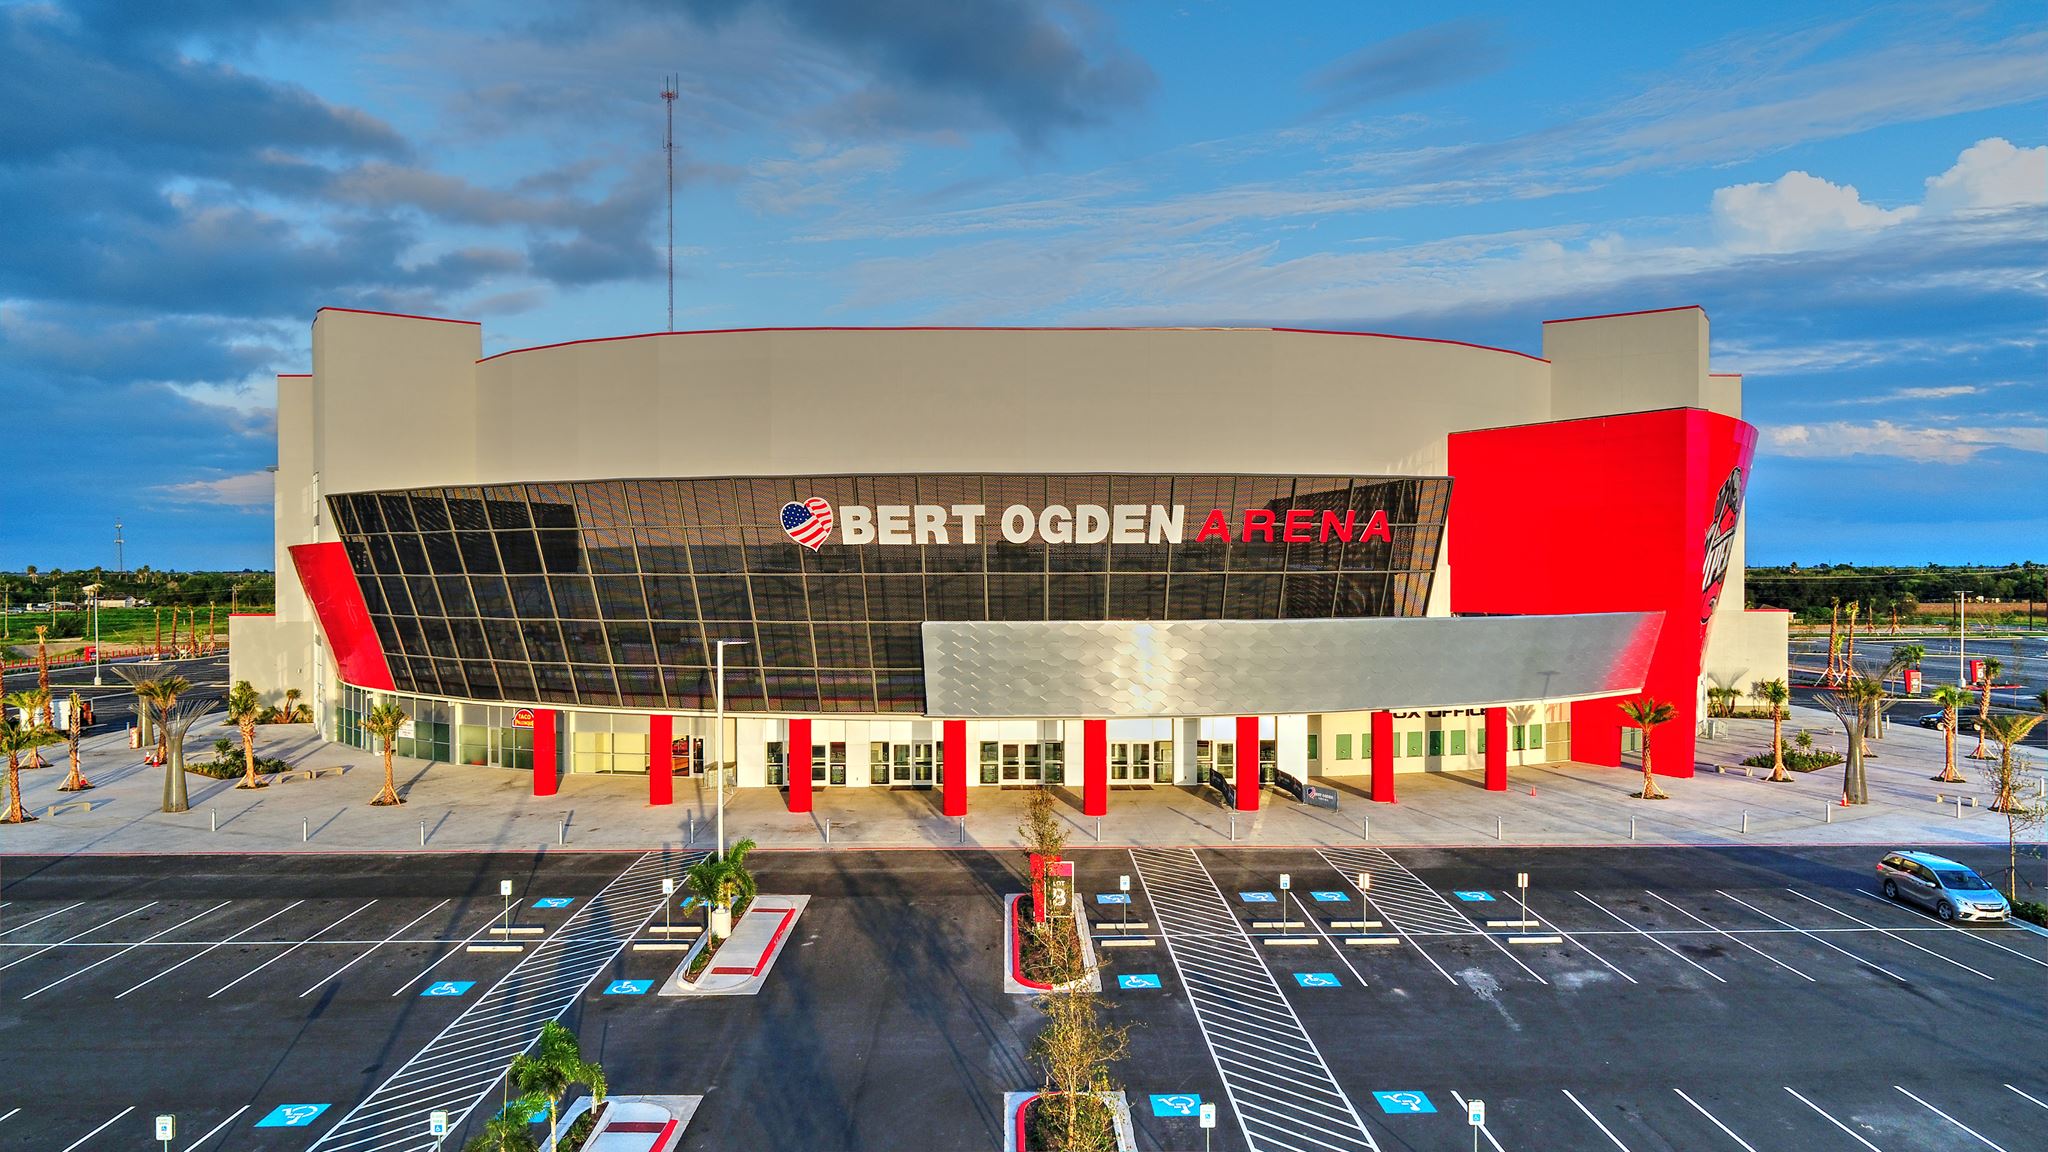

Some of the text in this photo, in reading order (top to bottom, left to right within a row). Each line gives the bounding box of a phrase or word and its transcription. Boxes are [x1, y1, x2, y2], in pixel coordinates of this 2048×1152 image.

[839, 504, 1392, 545] BERT OGDEN ARENA
